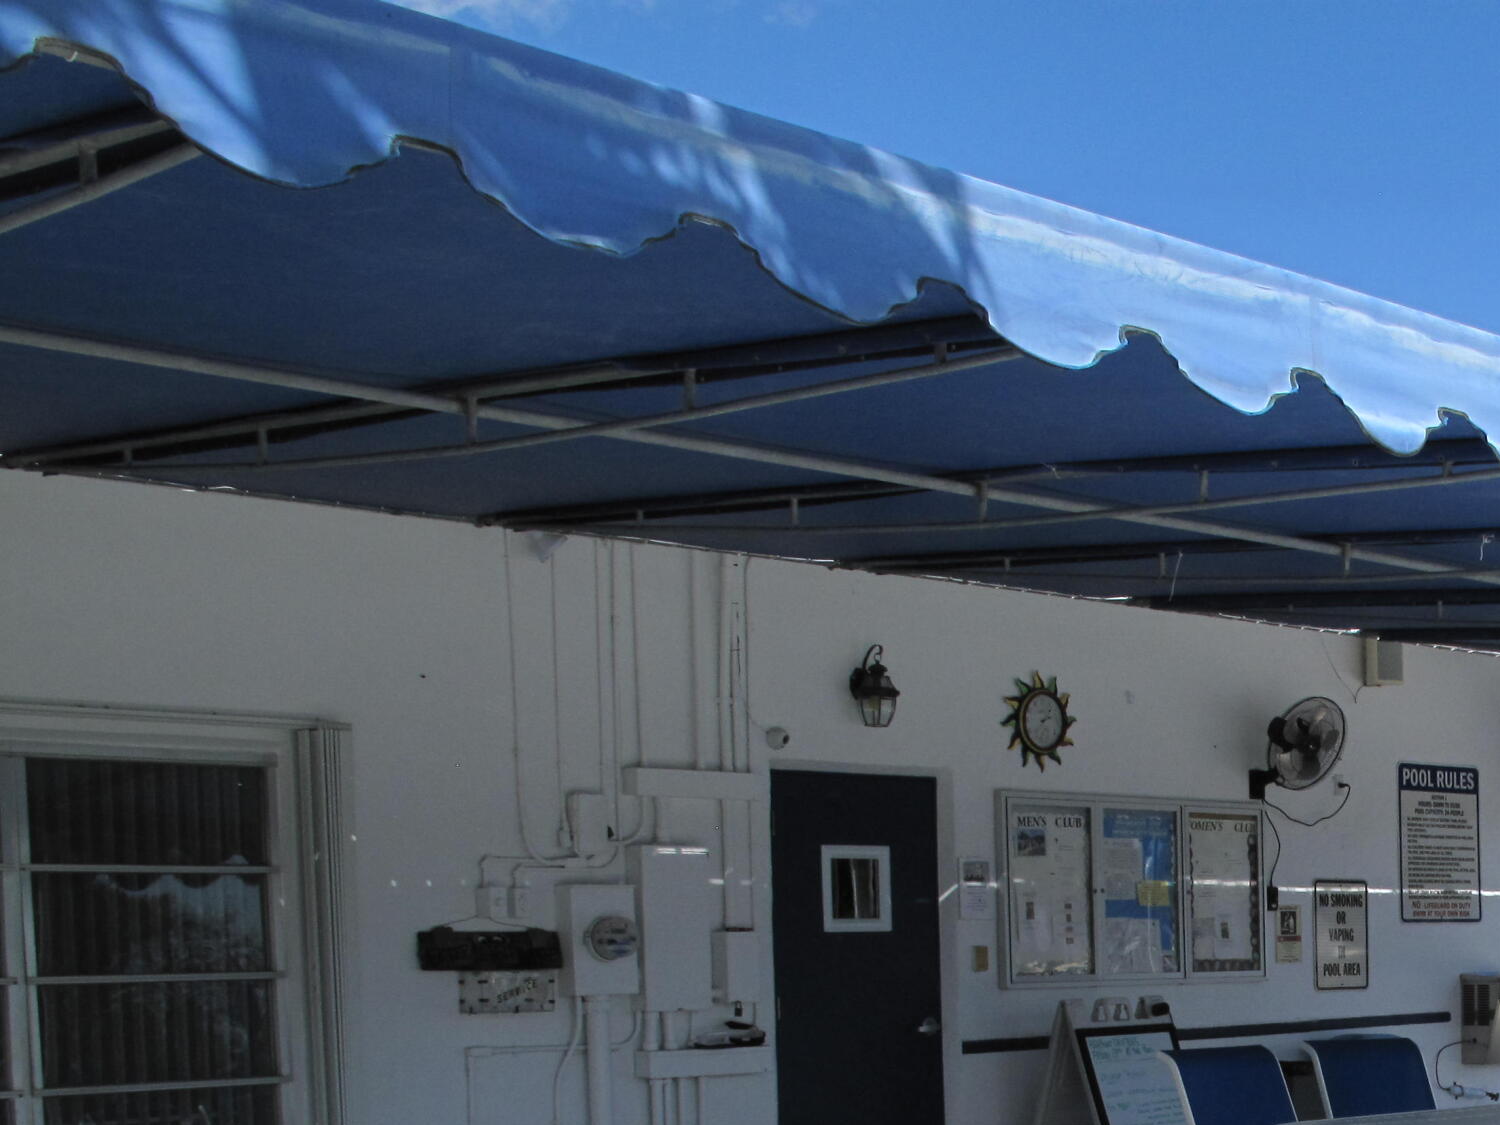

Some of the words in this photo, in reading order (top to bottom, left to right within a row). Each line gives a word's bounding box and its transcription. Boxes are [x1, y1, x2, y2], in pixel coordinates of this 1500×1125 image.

[1402, 767, 1434, 788] POOL
[1436, 770, 1474, 791] RULES
[1055, 816, 1082, 829] CLUB
[1319, 893, 1329, 906] NO
[1330, 893, 1363, 908] SMOKING
[1336, 911, 1346, 925] OR
[1329, 928, 1354, 942] VAPING
[1323, 963, 1341, 977] POOL
[1343, 963, 1361, 977] AREA
